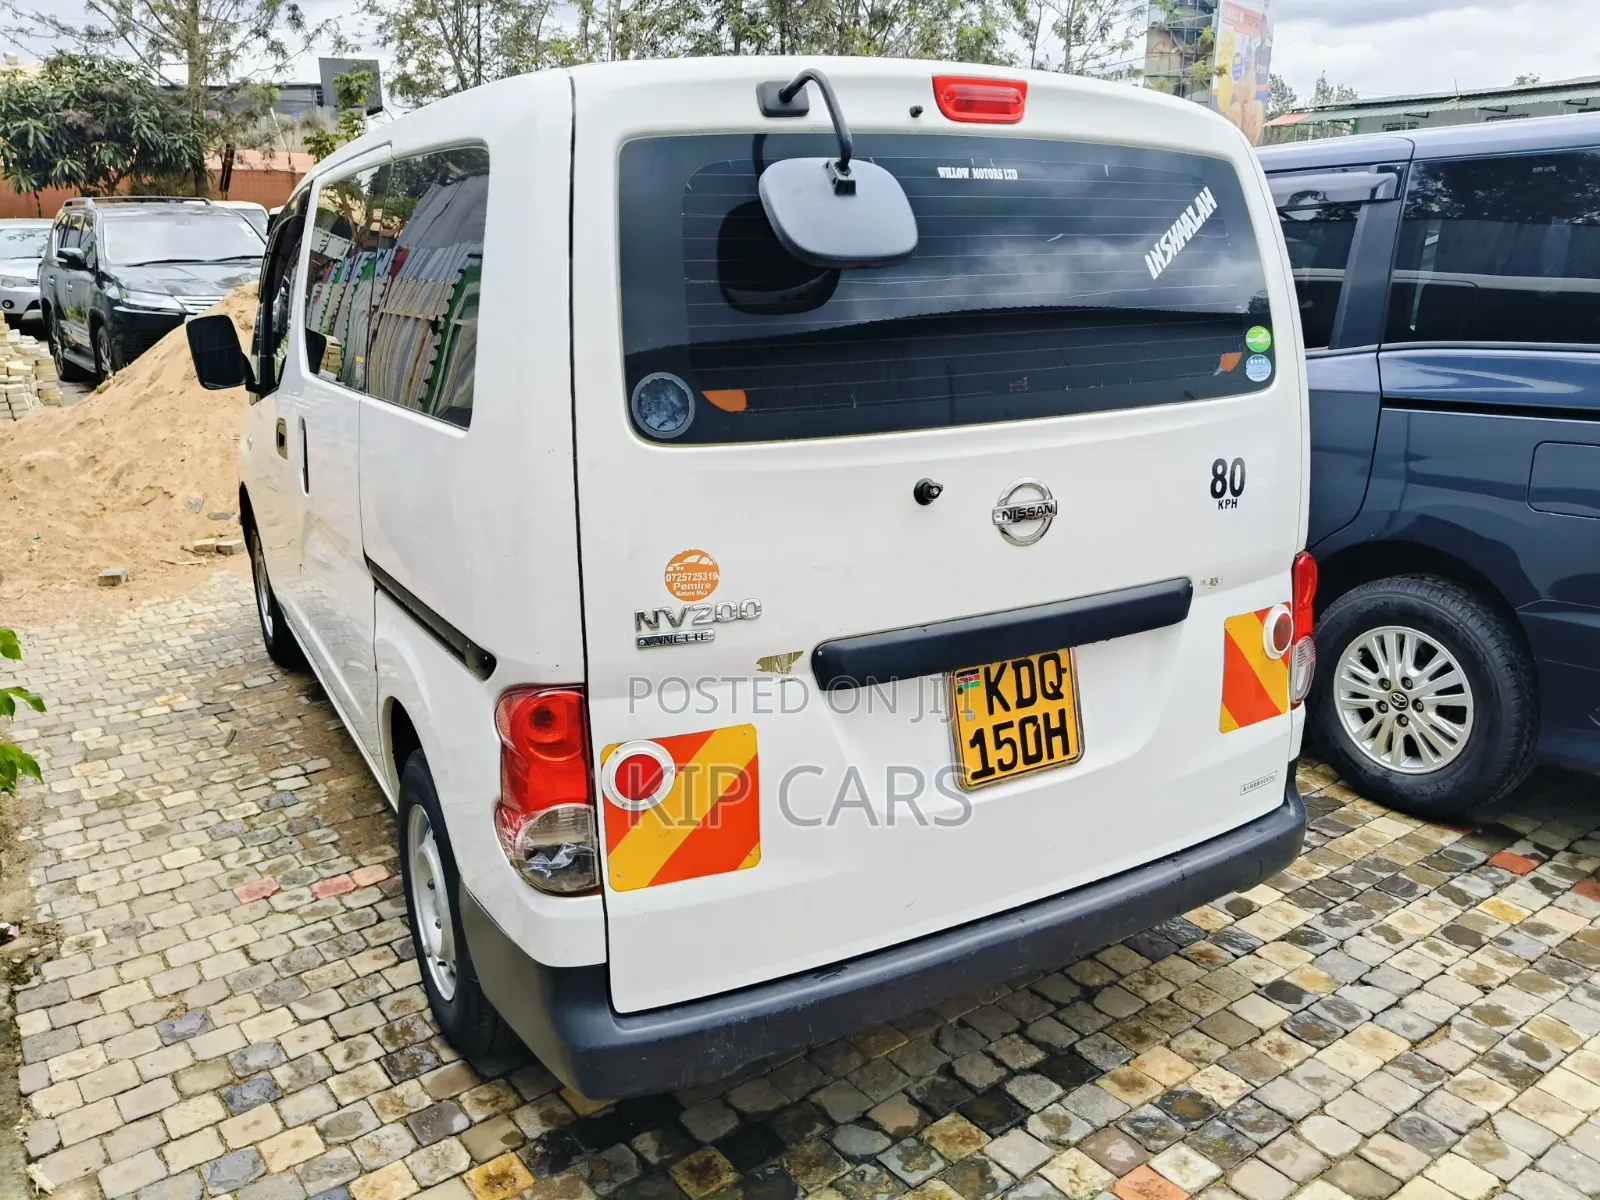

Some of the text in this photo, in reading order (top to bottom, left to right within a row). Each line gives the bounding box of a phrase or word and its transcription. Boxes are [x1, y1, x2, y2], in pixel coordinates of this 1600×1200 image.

[937, 166, 1018, 180] WILLOW MOTORS LTD
[1144, 185, 1218, 280] INSHAALAH
[1210, 457, 1246, 500] 80
[1001, 503, 1053, 521] NISSAN
[1217, 498, 1238, 510] KPH
[665, 571, 720, 582] 0725725319
[673, 581, 712, 591] Pemire
[634, 598, 761, 632] NV200
[984, 653, 1064, 716] KDQ
[969, 708, 1070, 780] 150H
